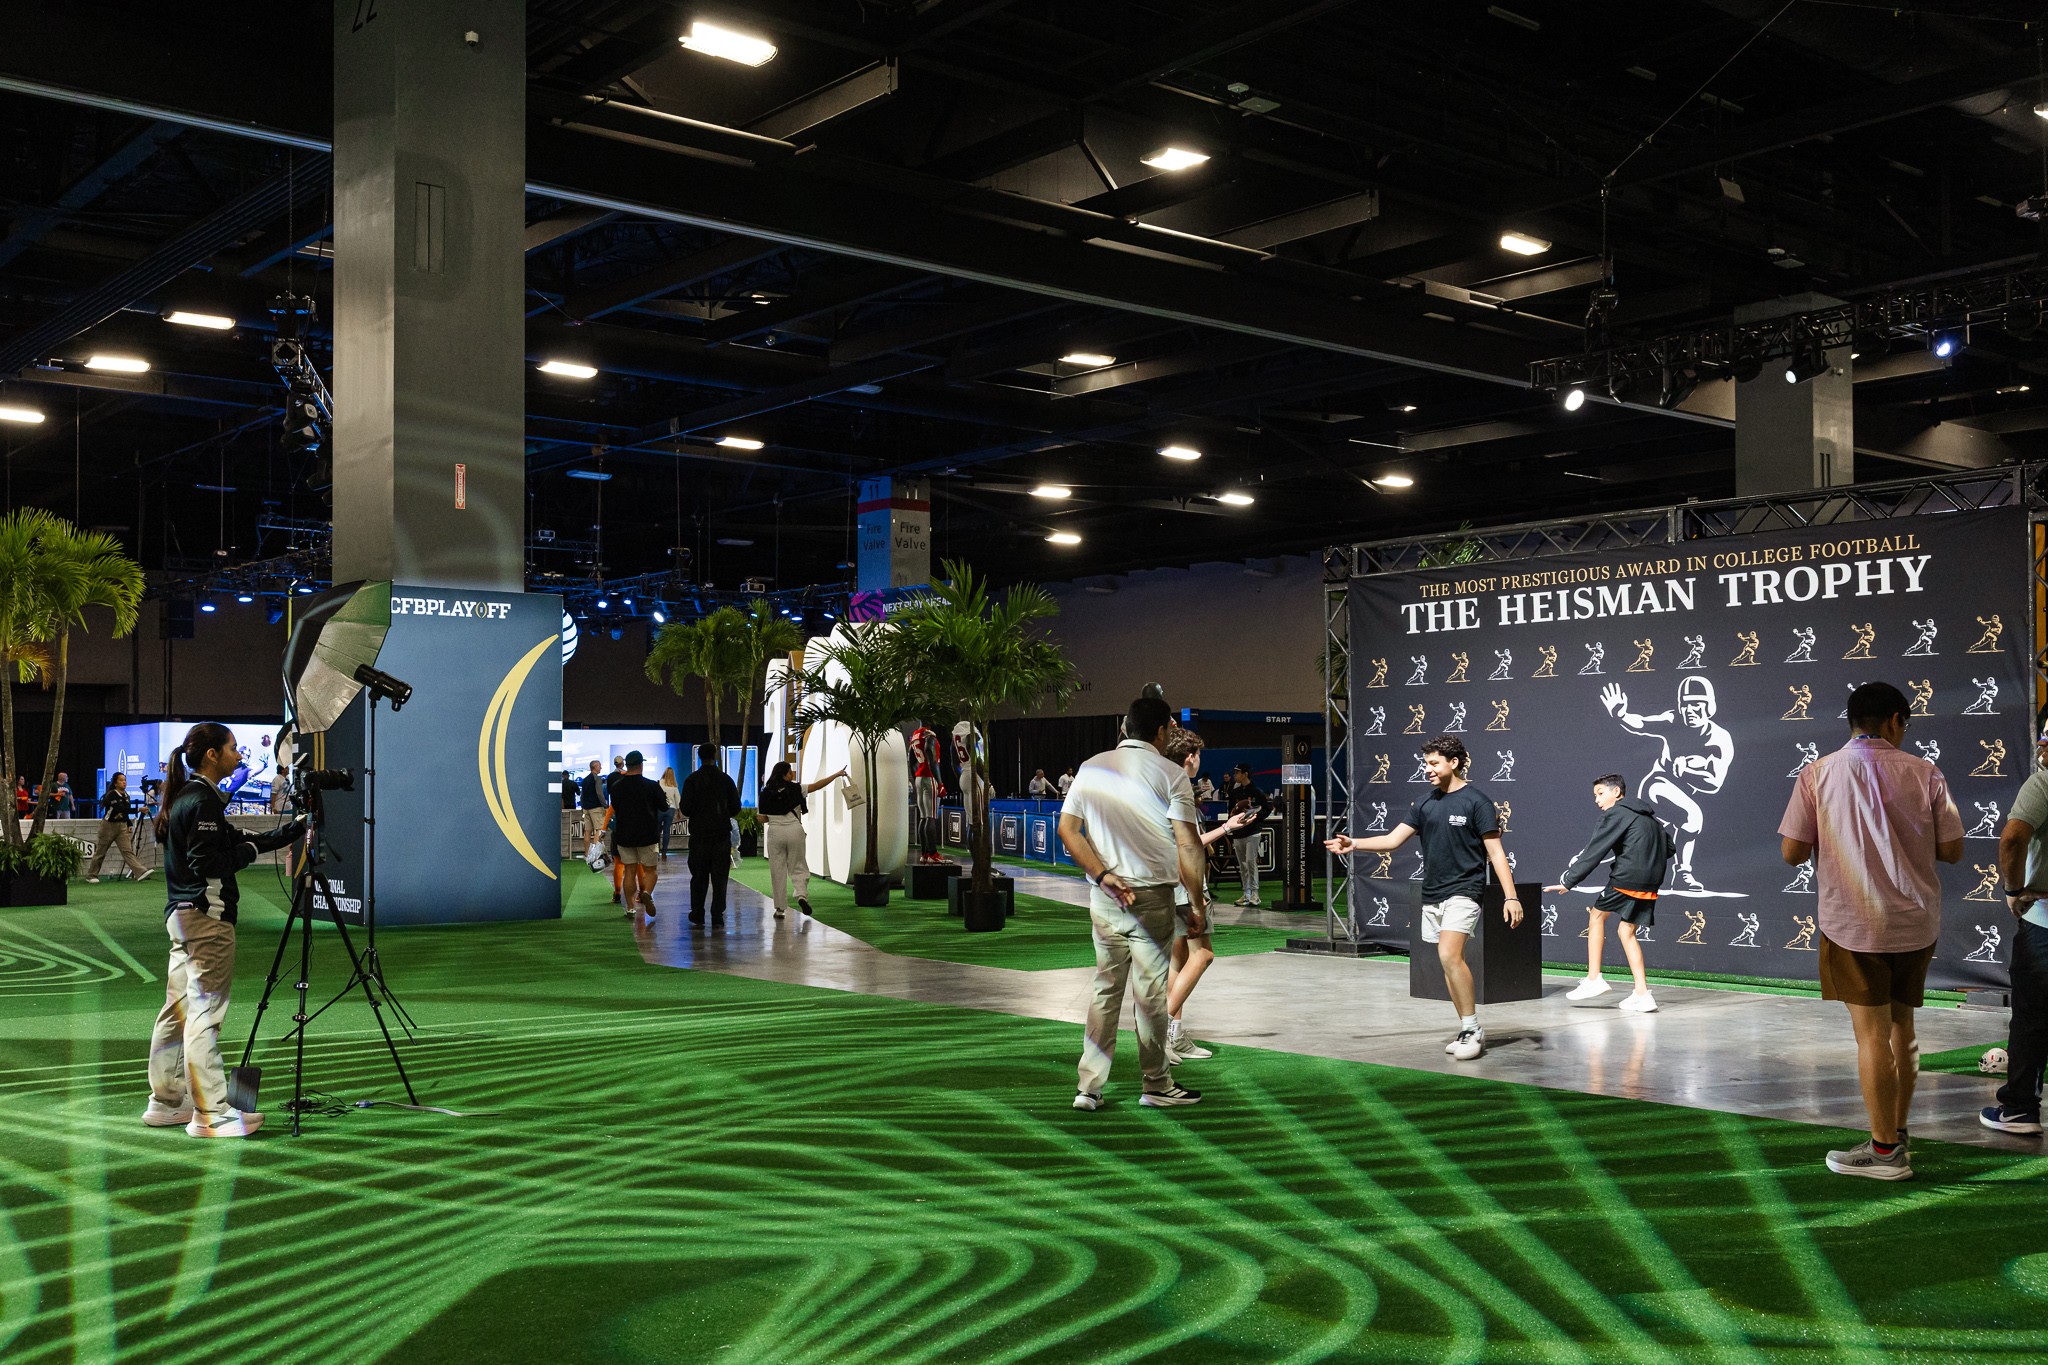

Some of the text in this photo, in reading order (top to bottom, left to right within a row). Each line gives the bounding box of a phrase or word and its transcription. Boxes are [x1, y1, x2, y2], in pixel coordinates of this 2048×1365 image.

[866, 523, 882, 535] Fire
[900, 521, 921, 535] Fire
[863, 539, 886, 551] Valve
[895, 537, 927, 551] Valve
[1420, 534, 1921, 598] THE MOST PRESTIGIOUS AWARD IN COLLEGE FOOTBALL
[1401, 554, 1932, 635] THE HEISMAN TROPHY
